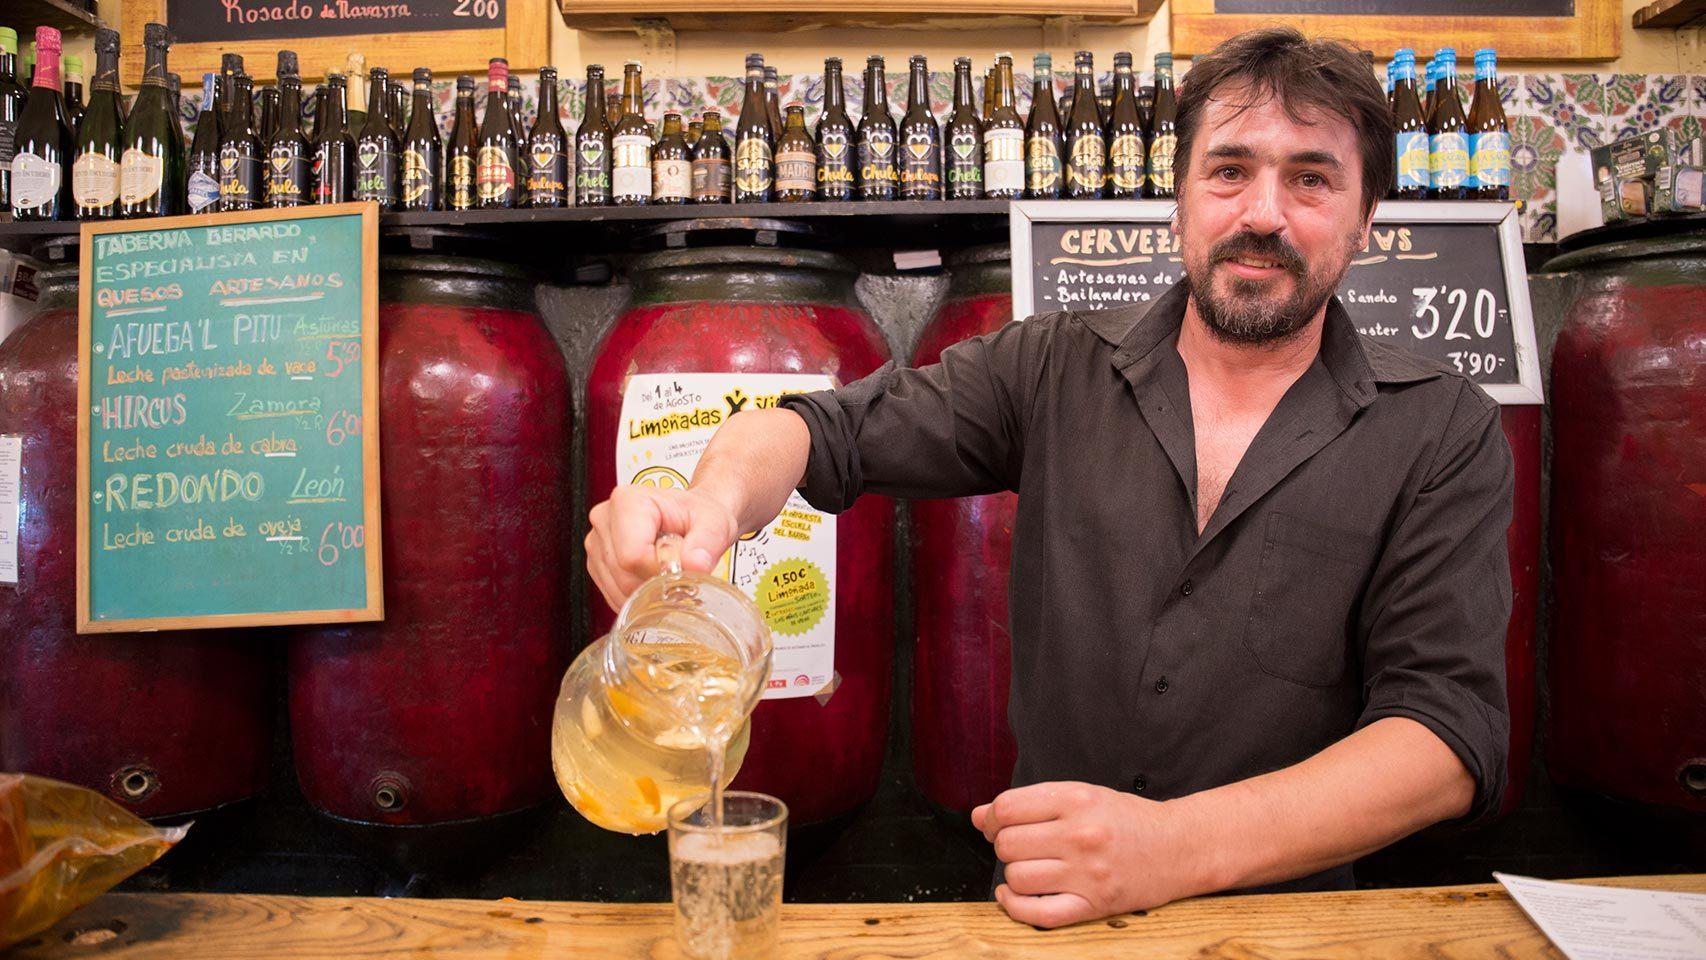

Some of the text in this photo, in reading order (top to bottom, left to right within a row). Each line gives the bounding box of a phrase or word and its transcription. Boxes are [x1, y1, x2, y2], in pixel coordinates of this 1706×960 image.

[221, 0, 313, 23] Rosado
[320, 5, 337, 18] de
[577, 172, 609, 188] Cheli
[817, 165, 855, 182] Chula
[949, 166, 981, 182] Cheli
[95, 230, 193, 259] TABERNA
[96, 247, 309, 283] ESPECIALISTA EN
[1057, 269, 1173, 285] Artesanas de
[97, 272, 344, 308] QUESOS ARTESANOS
[1347, 288, 1398, 304] Sancho
[233, 313, 281, 346] PITU
[107, 364, 154, 385] Leche
[257, 356, 277, 375] de
[654, 385, 661, 398] 1
[673, 381, 683, 395] 4
[101, 392, 321, 430] HIRCUS Zamora
[103, 431, 298, 463] Leche cruda de cabra
[105, 465, 345, 512] REDONDO León
[103, 514, 302, 551] Leche cruda de oveja
[767, 580, 816, 602] Limonada
[765, 610, 771, 619] 2
